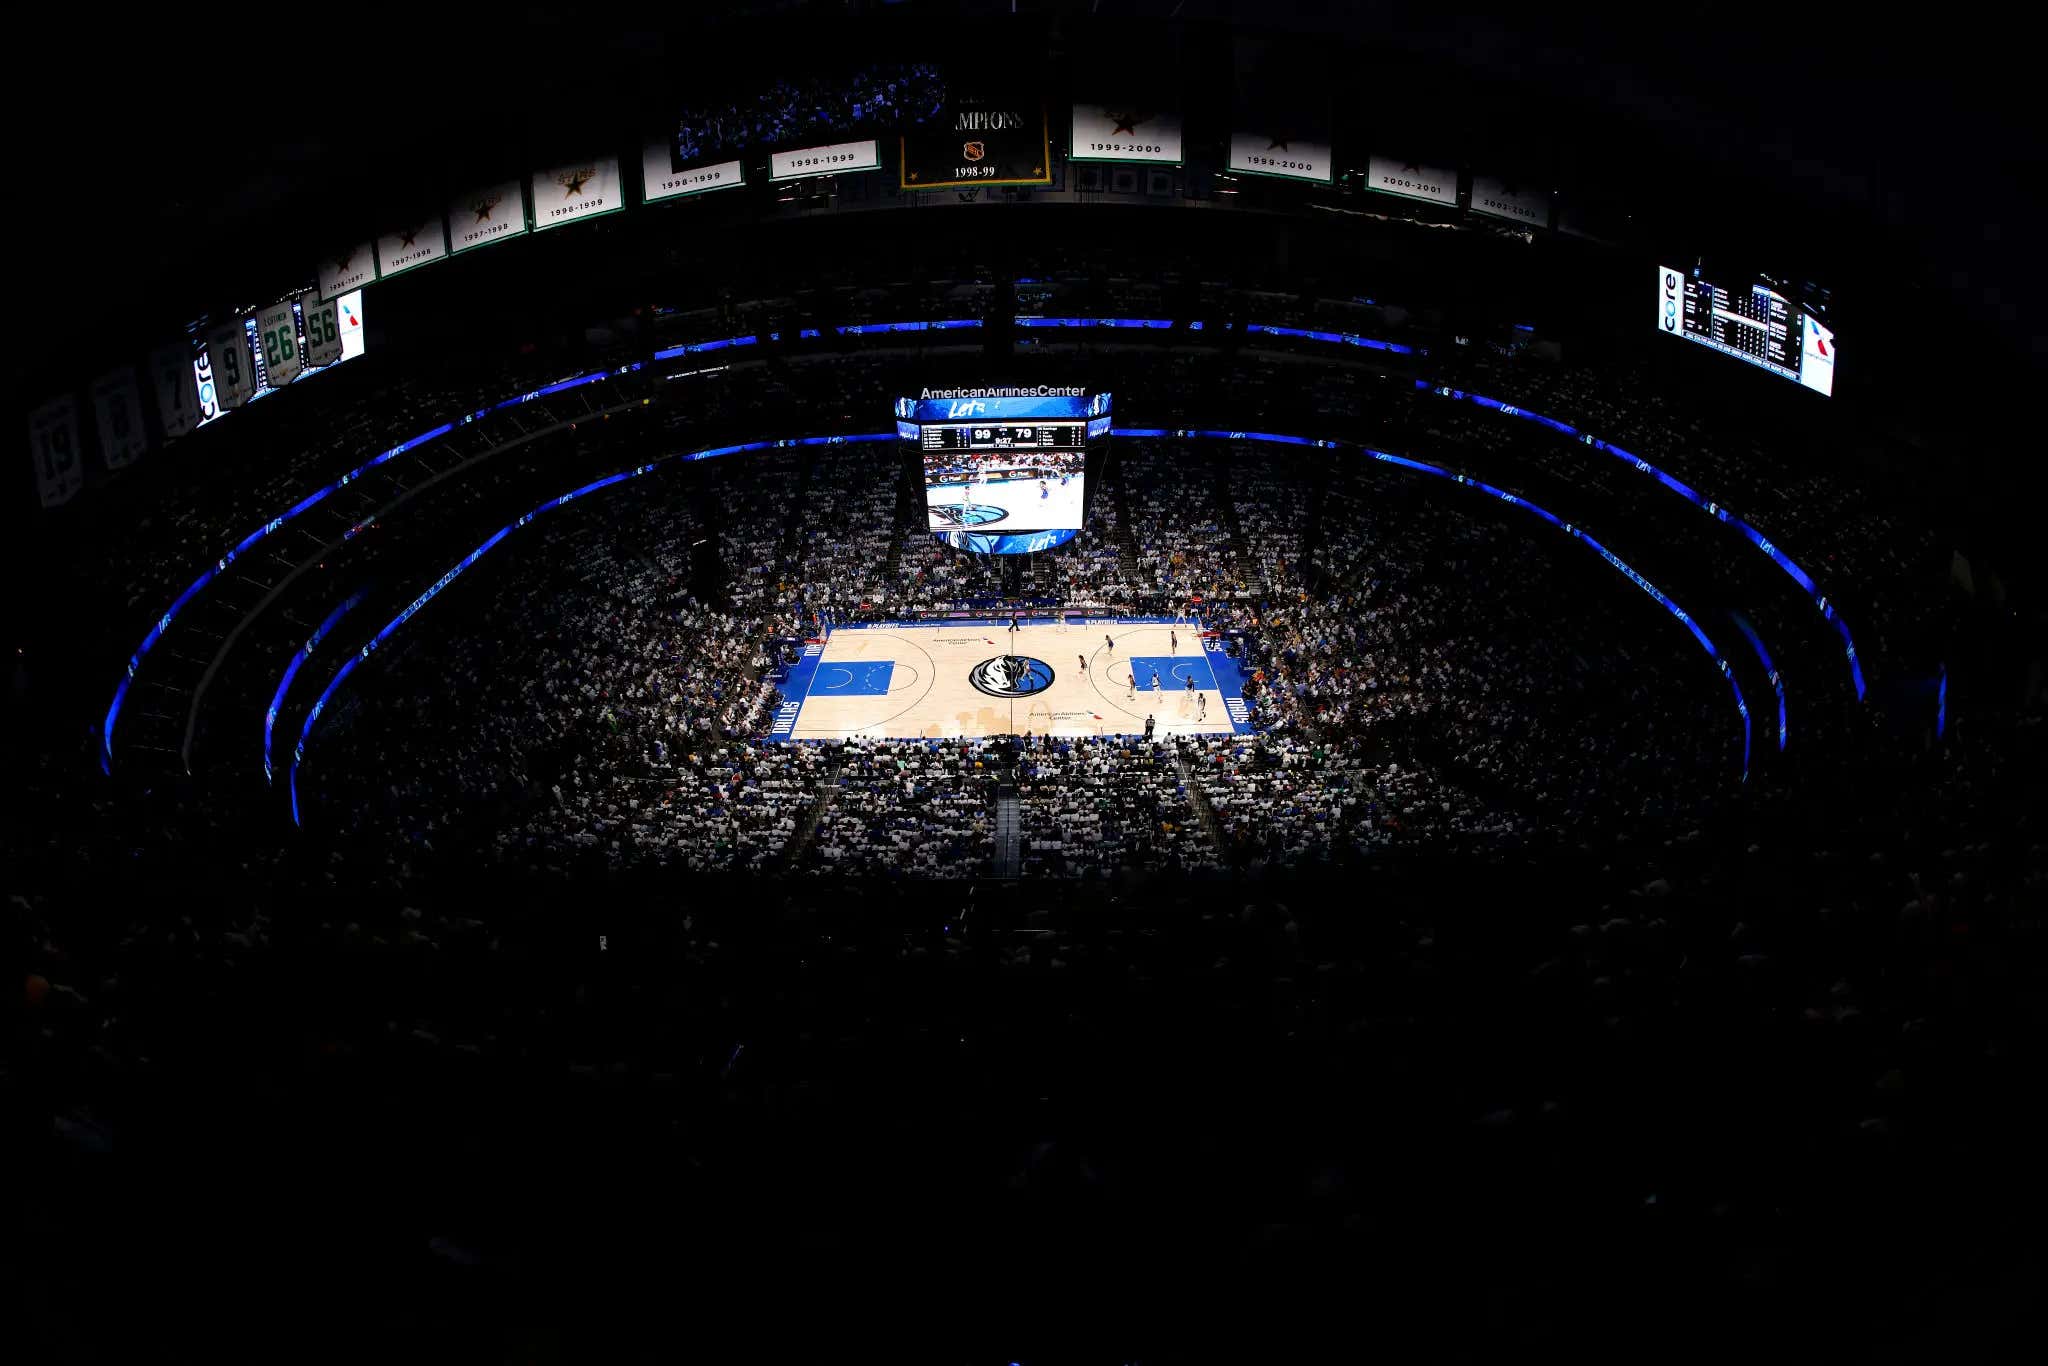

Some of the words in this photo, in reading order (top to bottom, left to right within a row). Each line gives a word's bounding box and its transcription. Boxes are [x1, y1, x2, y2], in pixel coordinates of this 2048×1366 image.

[1091, 143, 1161, 153] 1999-2000
[791, 153, 854, 168] 1998-1999
[1247, 156, 1312, 171] 1999-2000
[662, 172, 720, 190] 1998-1999
[954, 166, 995, 178] 1998-99
[1383, 176, 1441, 194] 2000-2001
[1664, 273, 1676, 332] core
[308, 308, 336, 348] 56
[263, 324, 295, 368] 26
[223, 346, 240, 386] 9
[974, 429, 991, 439] 99
[1015, 428, 1032, 438] 79
[772, 701, 800, 734] DALLAS
